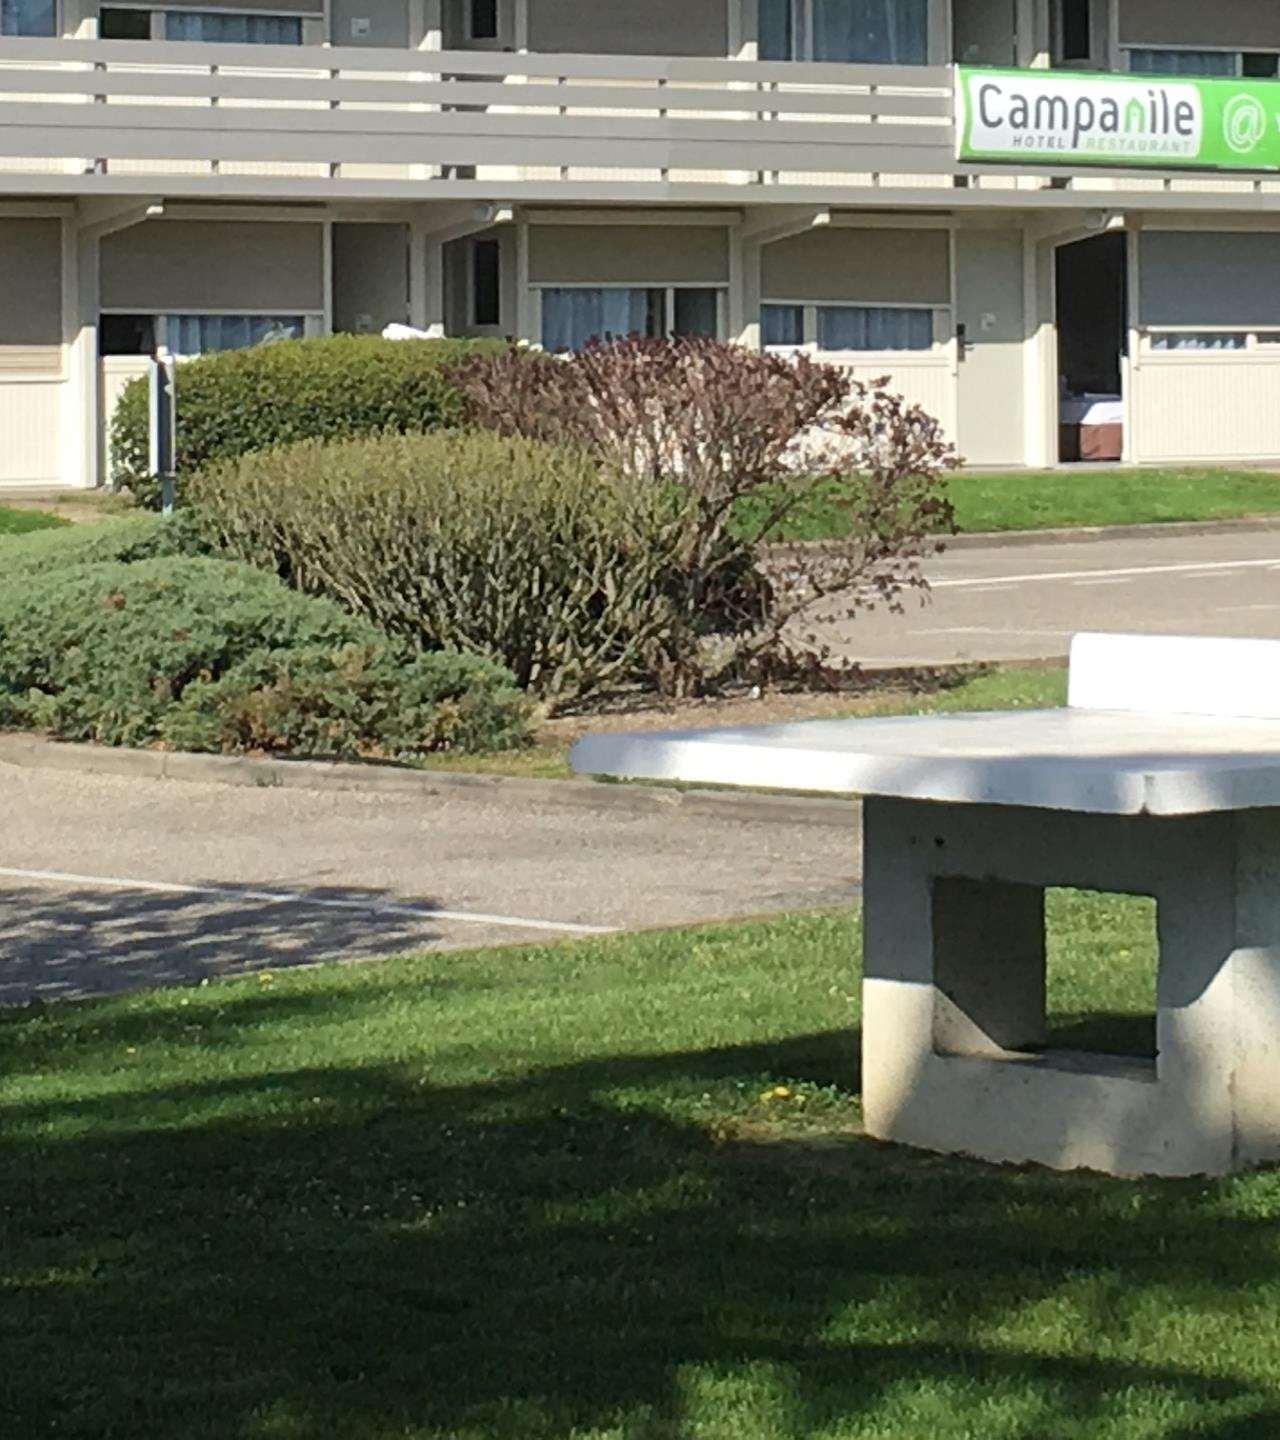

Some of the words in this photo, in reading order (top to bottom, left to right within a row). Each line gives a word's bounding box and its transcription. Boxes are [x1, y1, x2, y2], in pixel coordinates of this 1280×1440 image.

[978, 83, 1195, 149] Campanile
[1012, 135, 1066, 150] HOTEL
[1086, 137, 1191, 153] RESTAURANT
